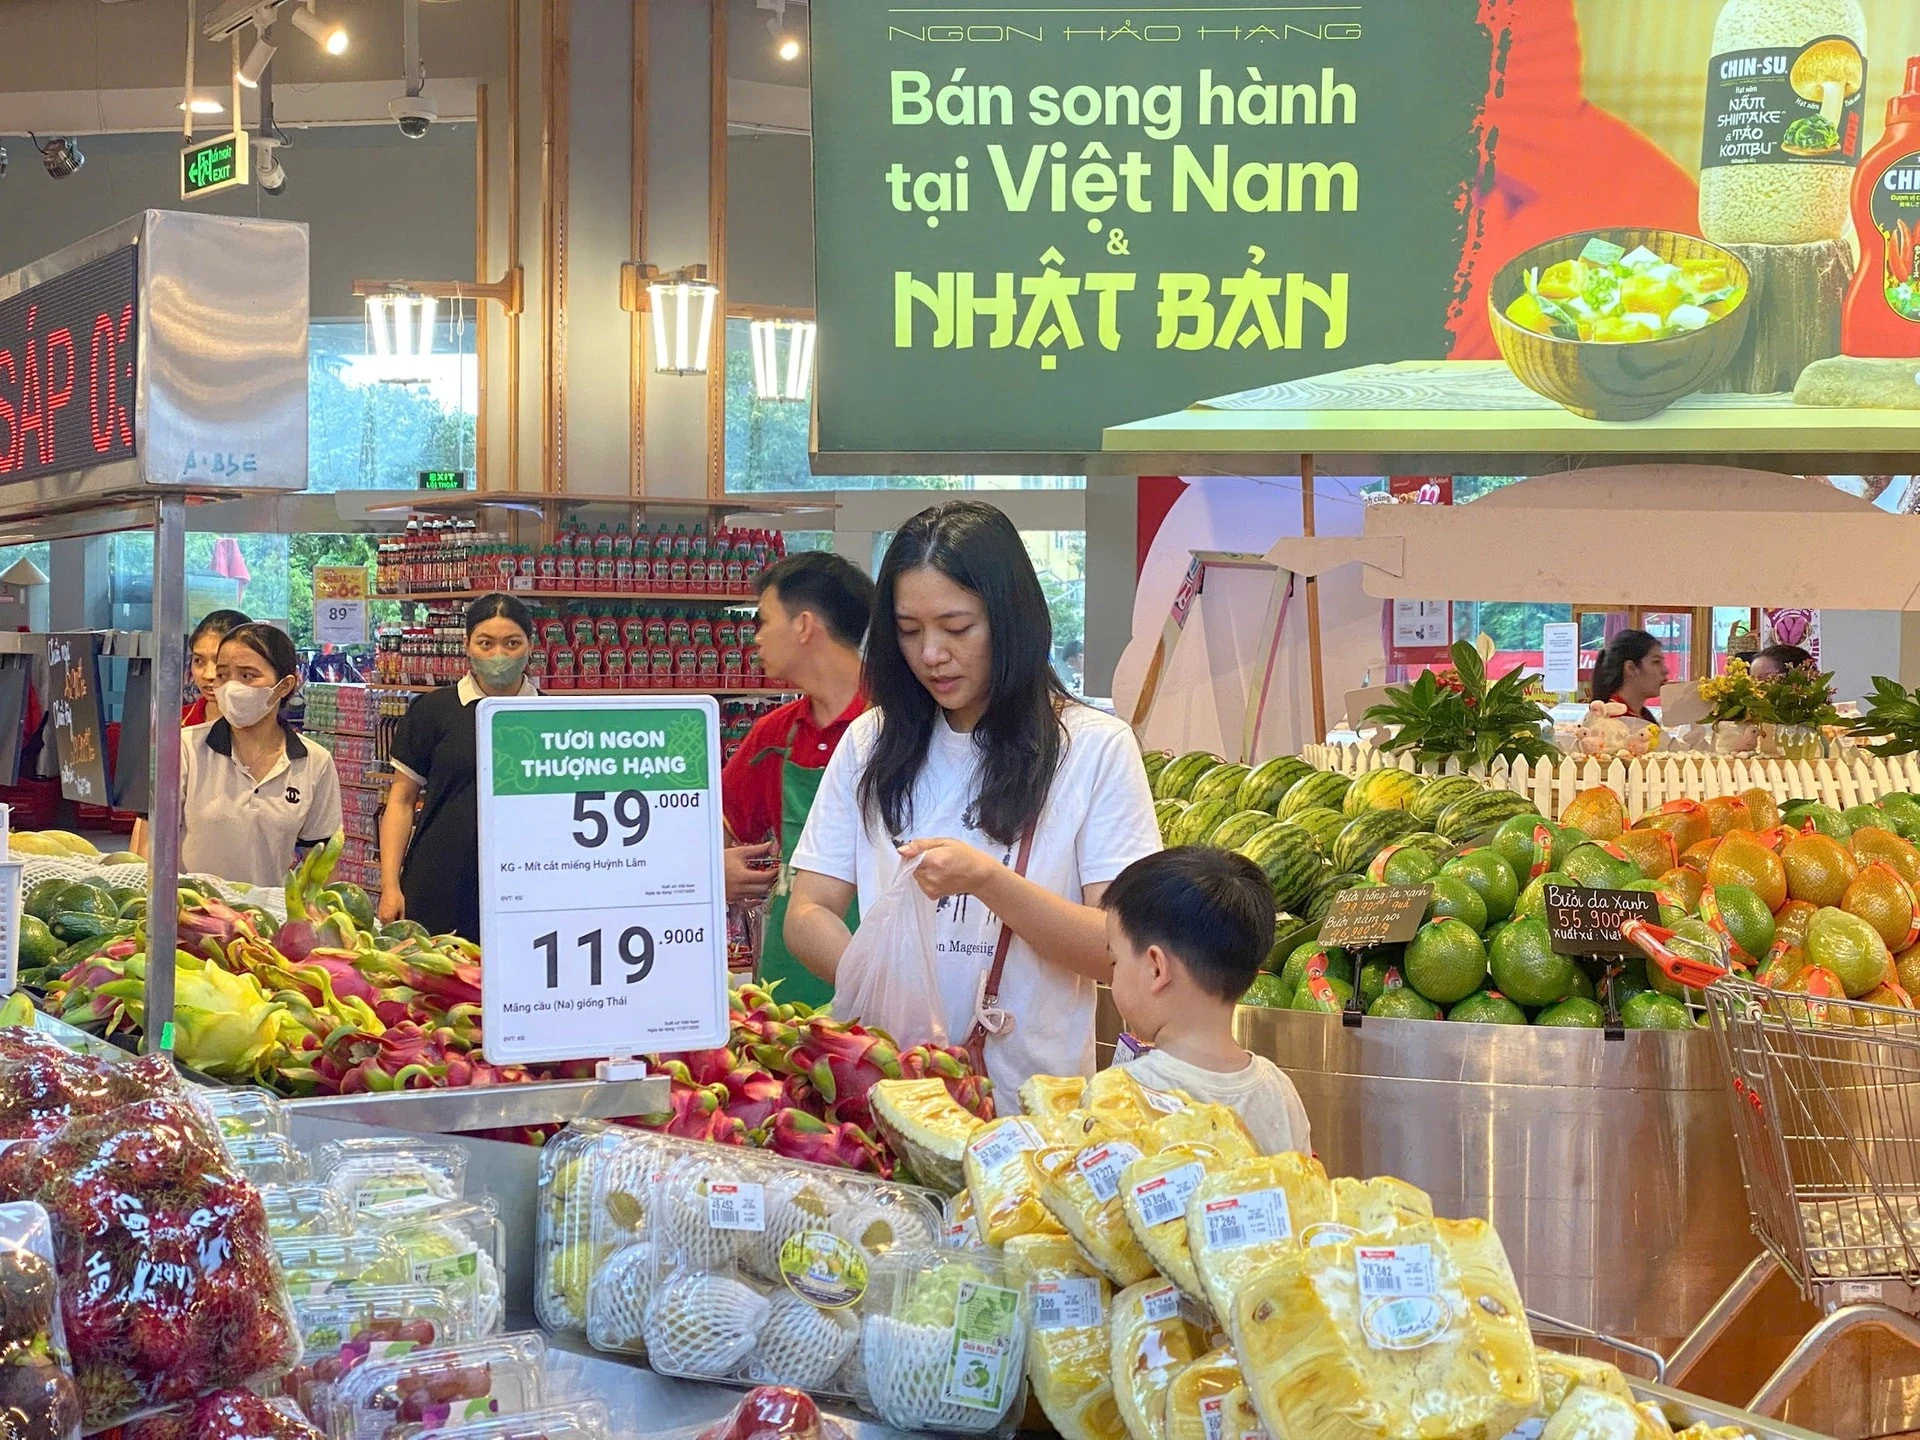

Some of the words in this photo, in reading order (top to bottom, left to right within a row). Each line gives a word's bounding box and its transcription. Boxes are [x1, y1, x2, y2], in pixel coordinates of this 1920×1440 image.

[889, 26, 1043, 42] NGON
[1064, 19, 1181, 42] HẢO
[1197, 24, 1362, 44] HẠNG
[1720, 56, 1787, 80] CHIN-SU
[890, 68, 1014, 126] Bán
[1029, 83, 1182, 140] song
[1199, 67, 1357, 125] hành
[1717, 110, 1781, 127] SHIITAKE
[1719, 142, 1772, 157] KOMBU
[213, 164, 231, 182] EXIT
[885, 155, 969, 228] tại
[987, 141, 1152, 233] Việt
[1172, 144, 1358, 213] Nam
[1106, 228, 1130, 255] &
[894, 246, 1136, 370] NHẬT
[1156, 245, 1349, 351] BẢN
[429, 473, 456, 481] EXIT
[329, 607, 347, 620] 89
[540, 729, 592, 750] TƯƠI
[599, 730, 665, 749] NGON
[520, 756, 617, 782] THƯỢNG
[623, 756, 687, 776] HẠNG
[571, 789, 650, 849] 59
[500, 863, 515, 872] KG
[524, 861, 541, 872] Mít
[561, 859, 591, 873] miếng
[593, 858, 624, 871] Huỳnh
[625, 857, 647, 868] Lâm
[1587, 890, 1609, 909] da
[532, 925, 656, 989] 119
[658, 928, 704, 946] .900đ
[554, 1000, 575, 1012] (Na)
